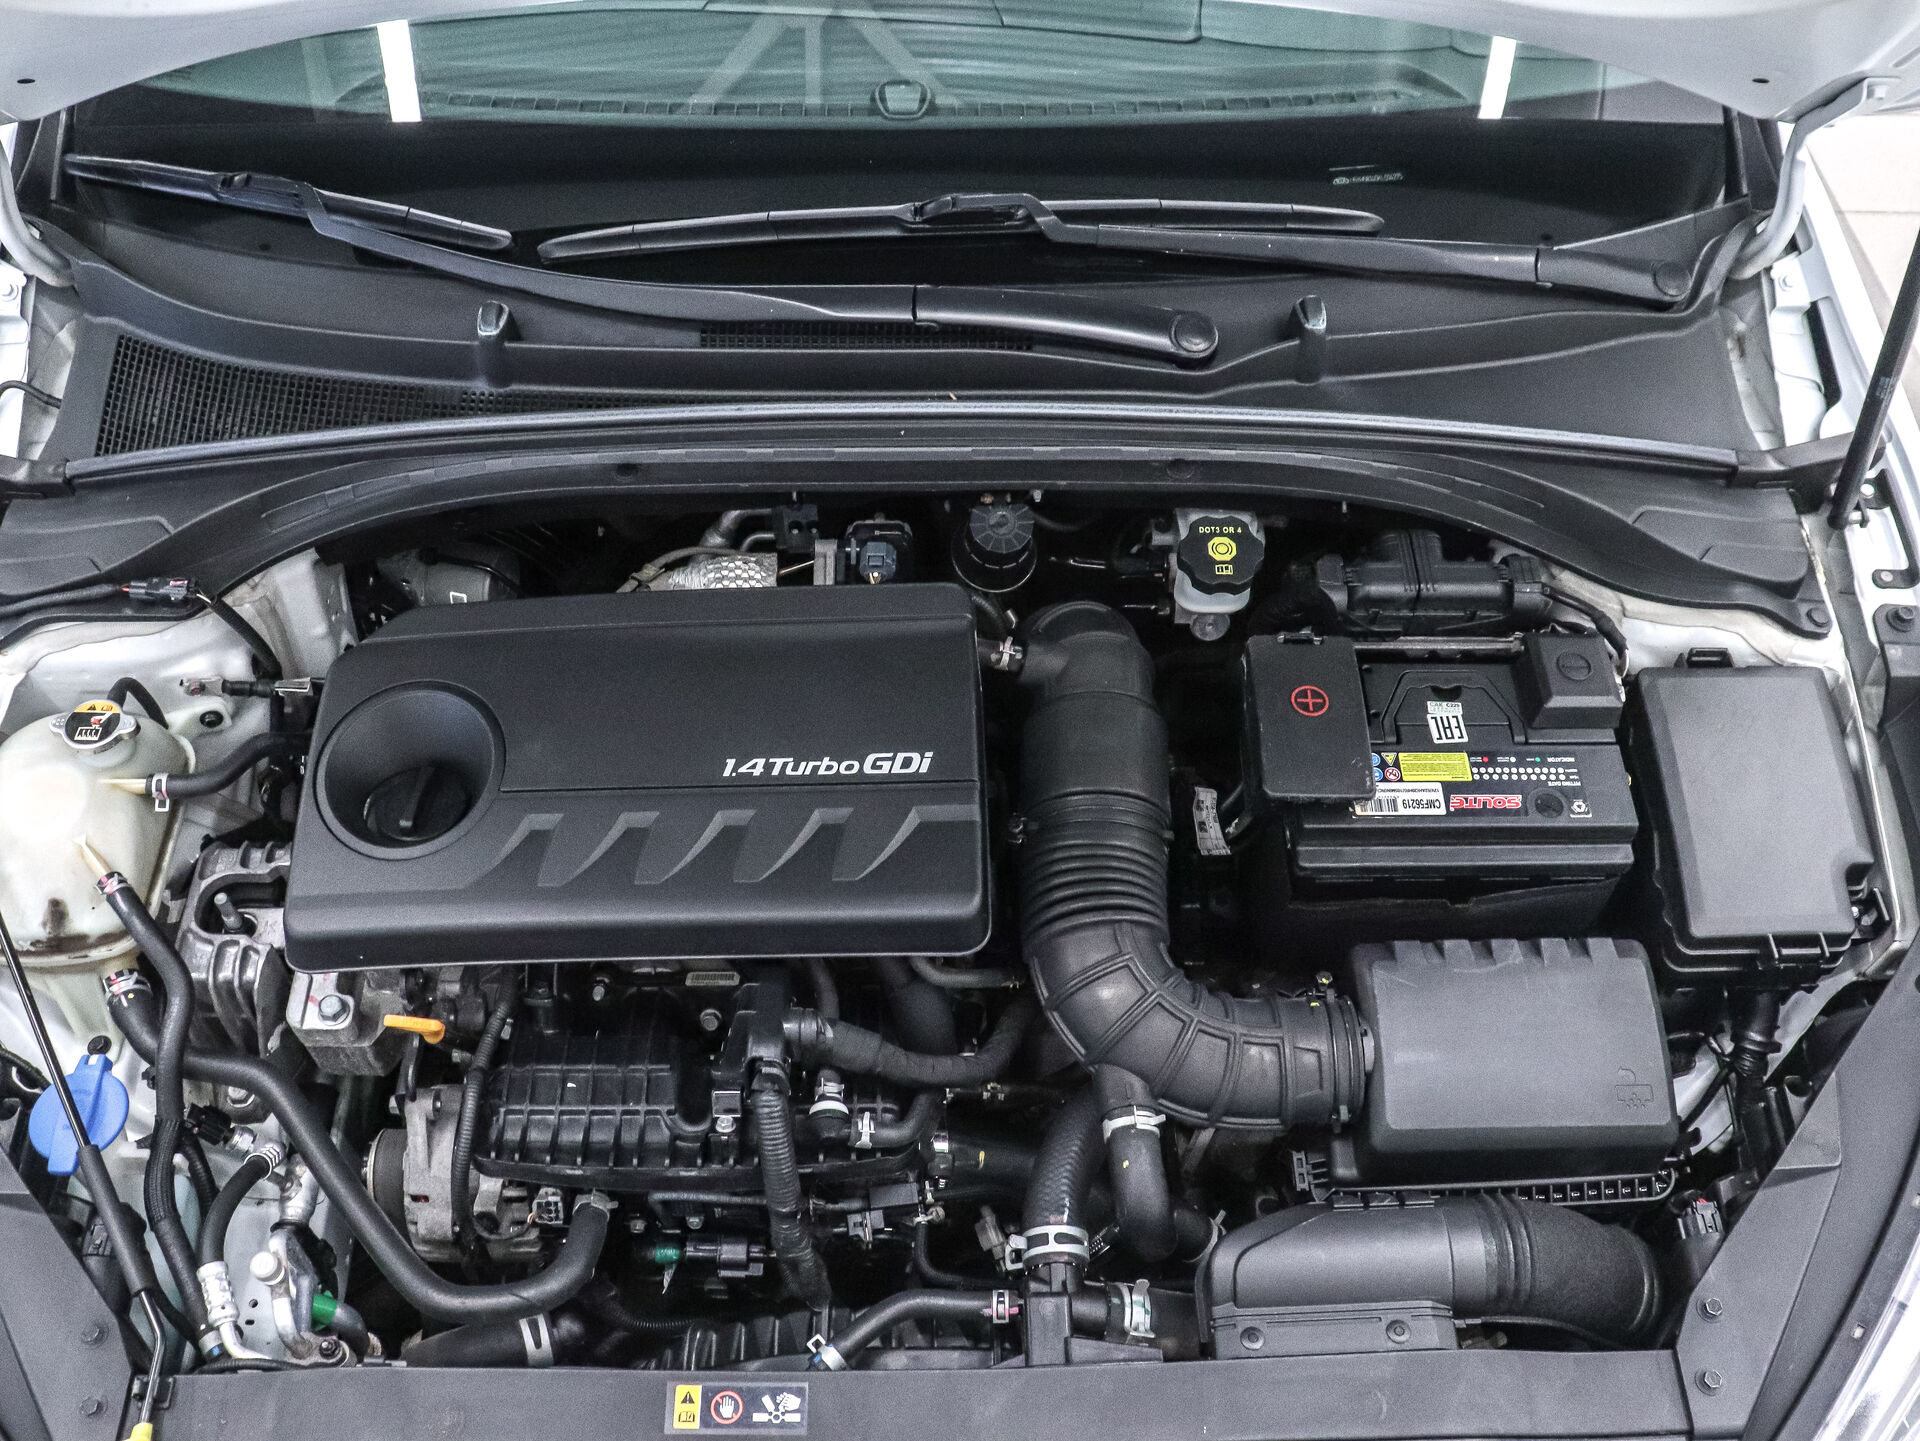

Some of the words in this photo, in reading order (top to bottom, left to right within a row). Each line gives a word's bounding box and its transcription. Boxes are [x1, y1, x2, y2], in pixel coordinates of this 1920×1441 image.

[1199, 526, 1220, 534] DOT3
[1222, 526, 1235, 534] OR
[1237, 526, 1242, 534] 4
[1430, 715, 1464, 740] EAC
[722, 758, 766, 777] 1.4
[768, 757, 860, 776] Turbo
[862, 751, 934, 775] GDi
[1402, 798, 1441, 810] CMF56219
[1450, 795, 1522, 809] SOLITE
